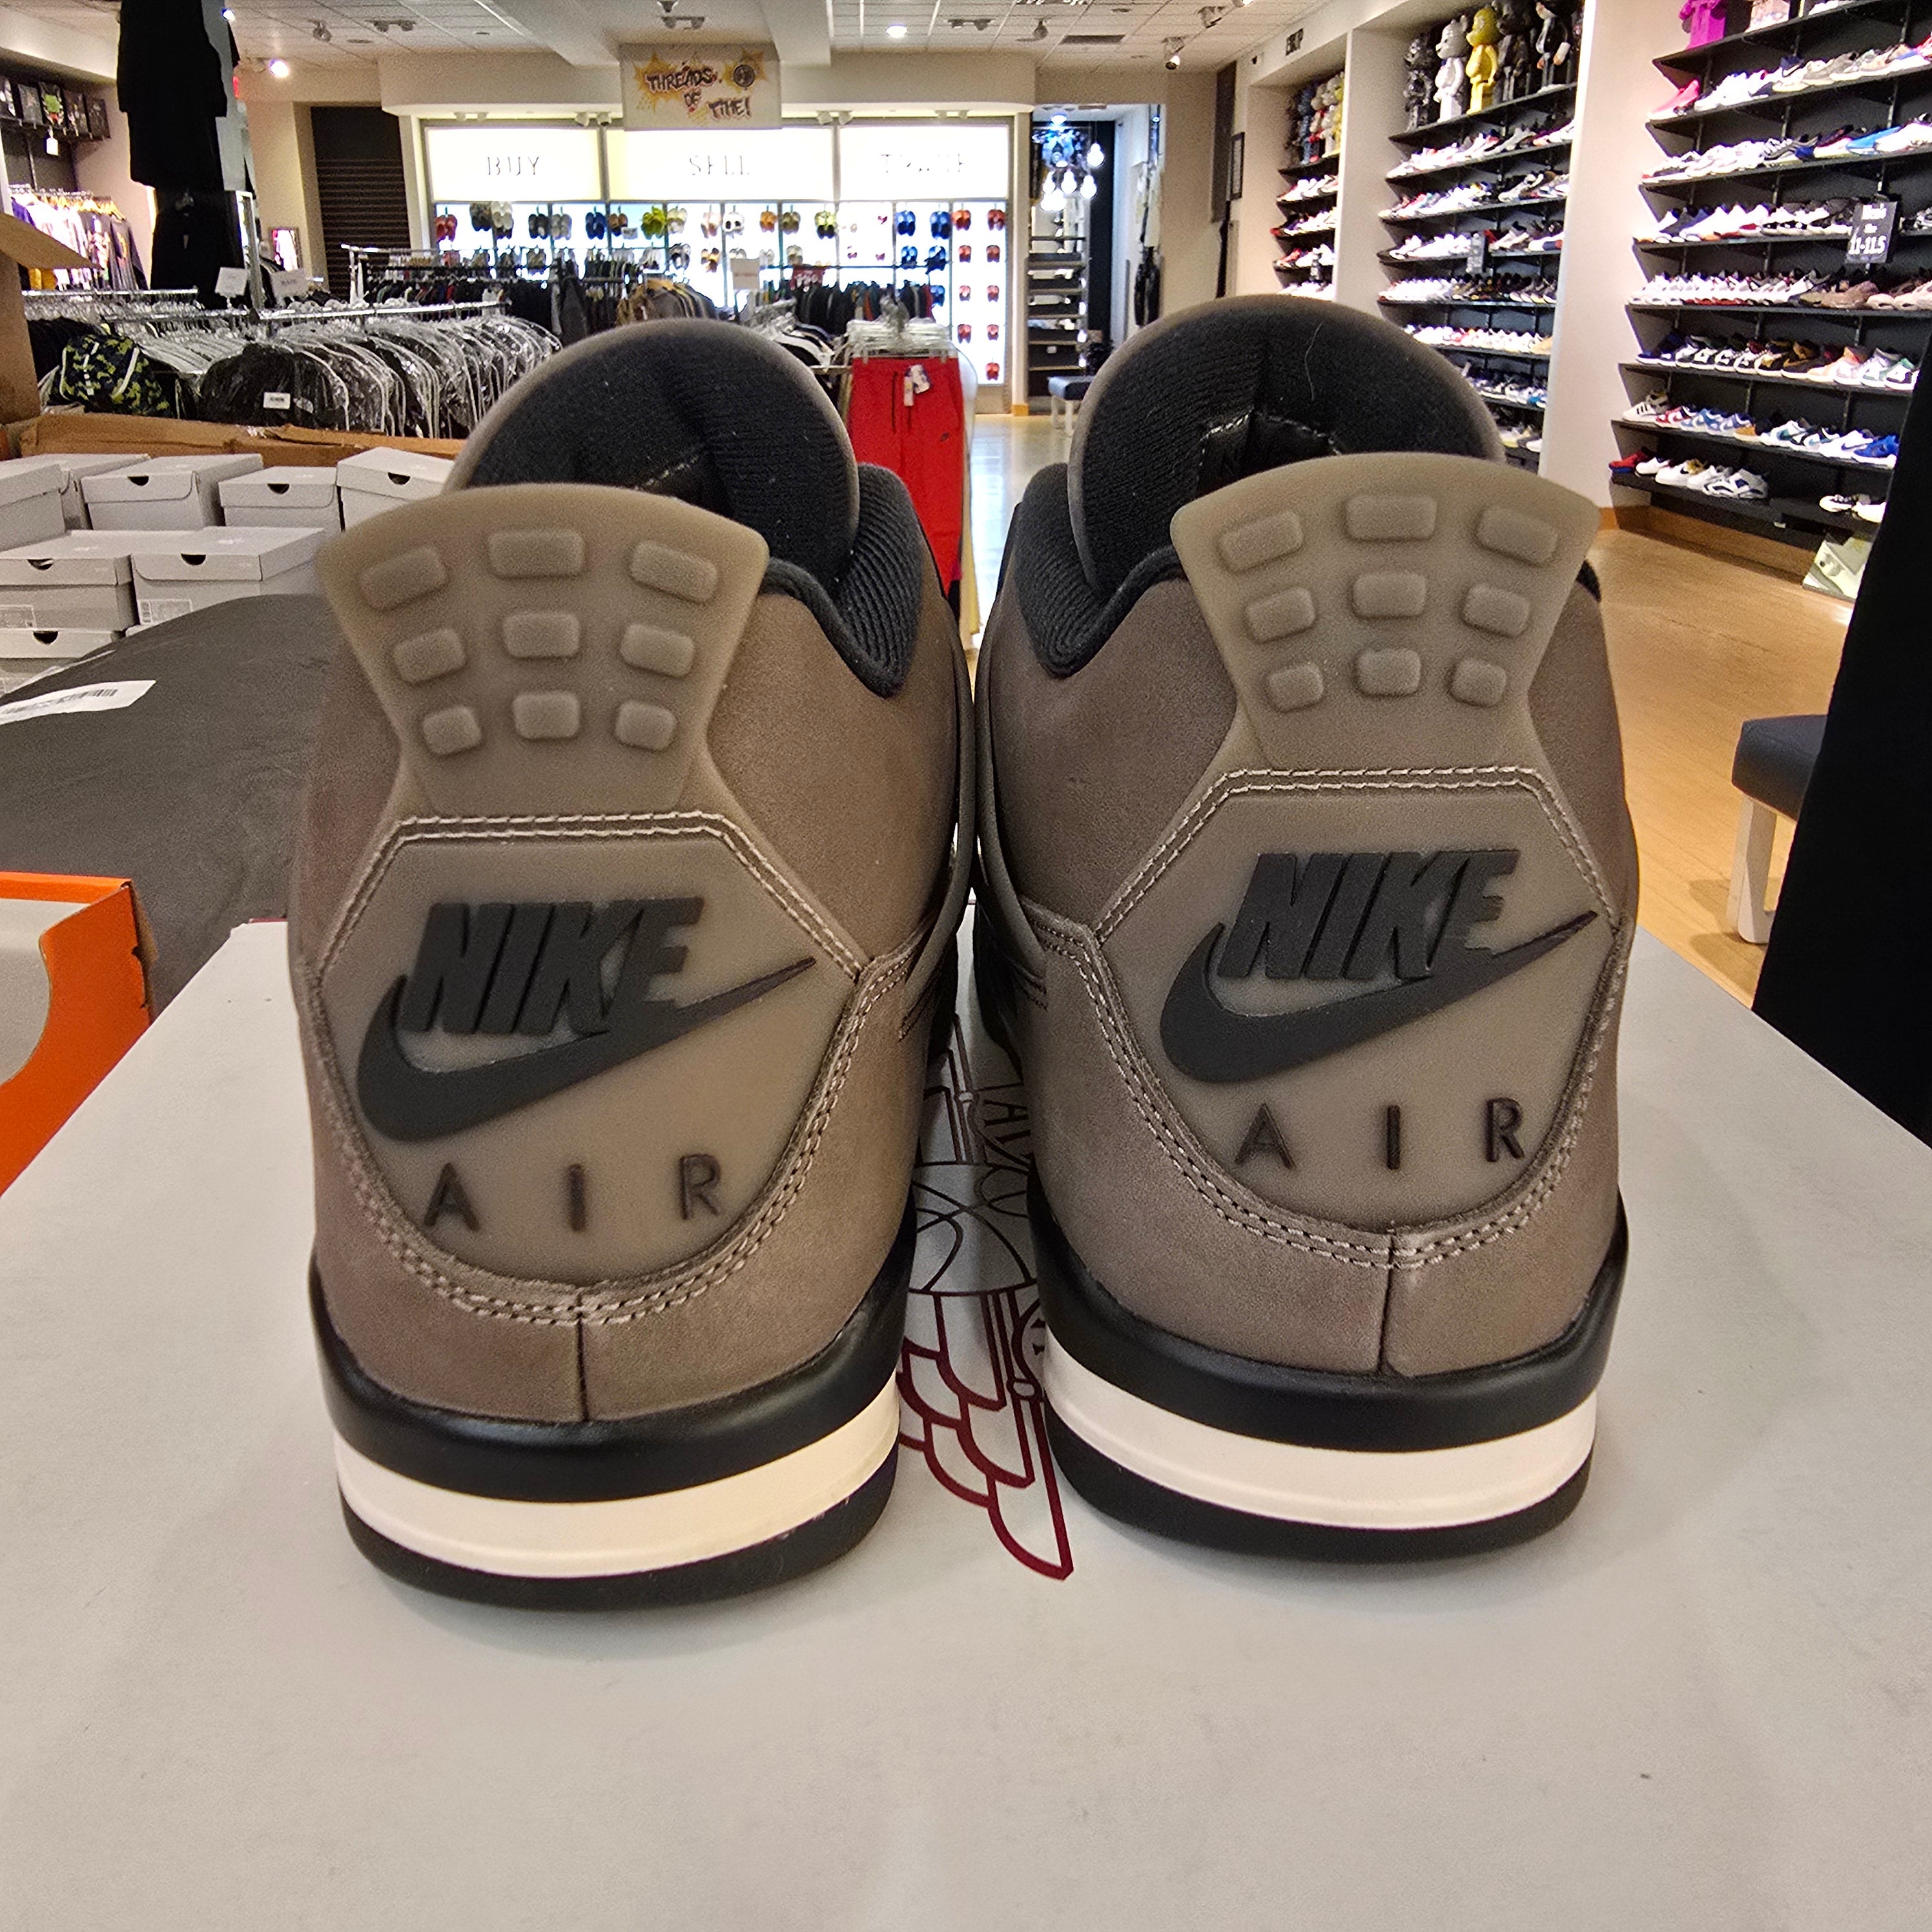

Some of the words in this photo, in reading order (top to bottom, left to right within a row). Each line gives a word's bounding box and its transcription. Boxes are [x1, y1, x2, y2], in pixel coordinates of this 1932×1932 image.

[487, 156, 540, 176] BUY
[688, 154, 750, 176] SELL
[1217, 848, 1520, 980] NIKE
[395, 896, 705, 1036] NIKE
[1232, 1096, 1526, 1172] AIR
[422, 1152, 721, 1233] AIR
